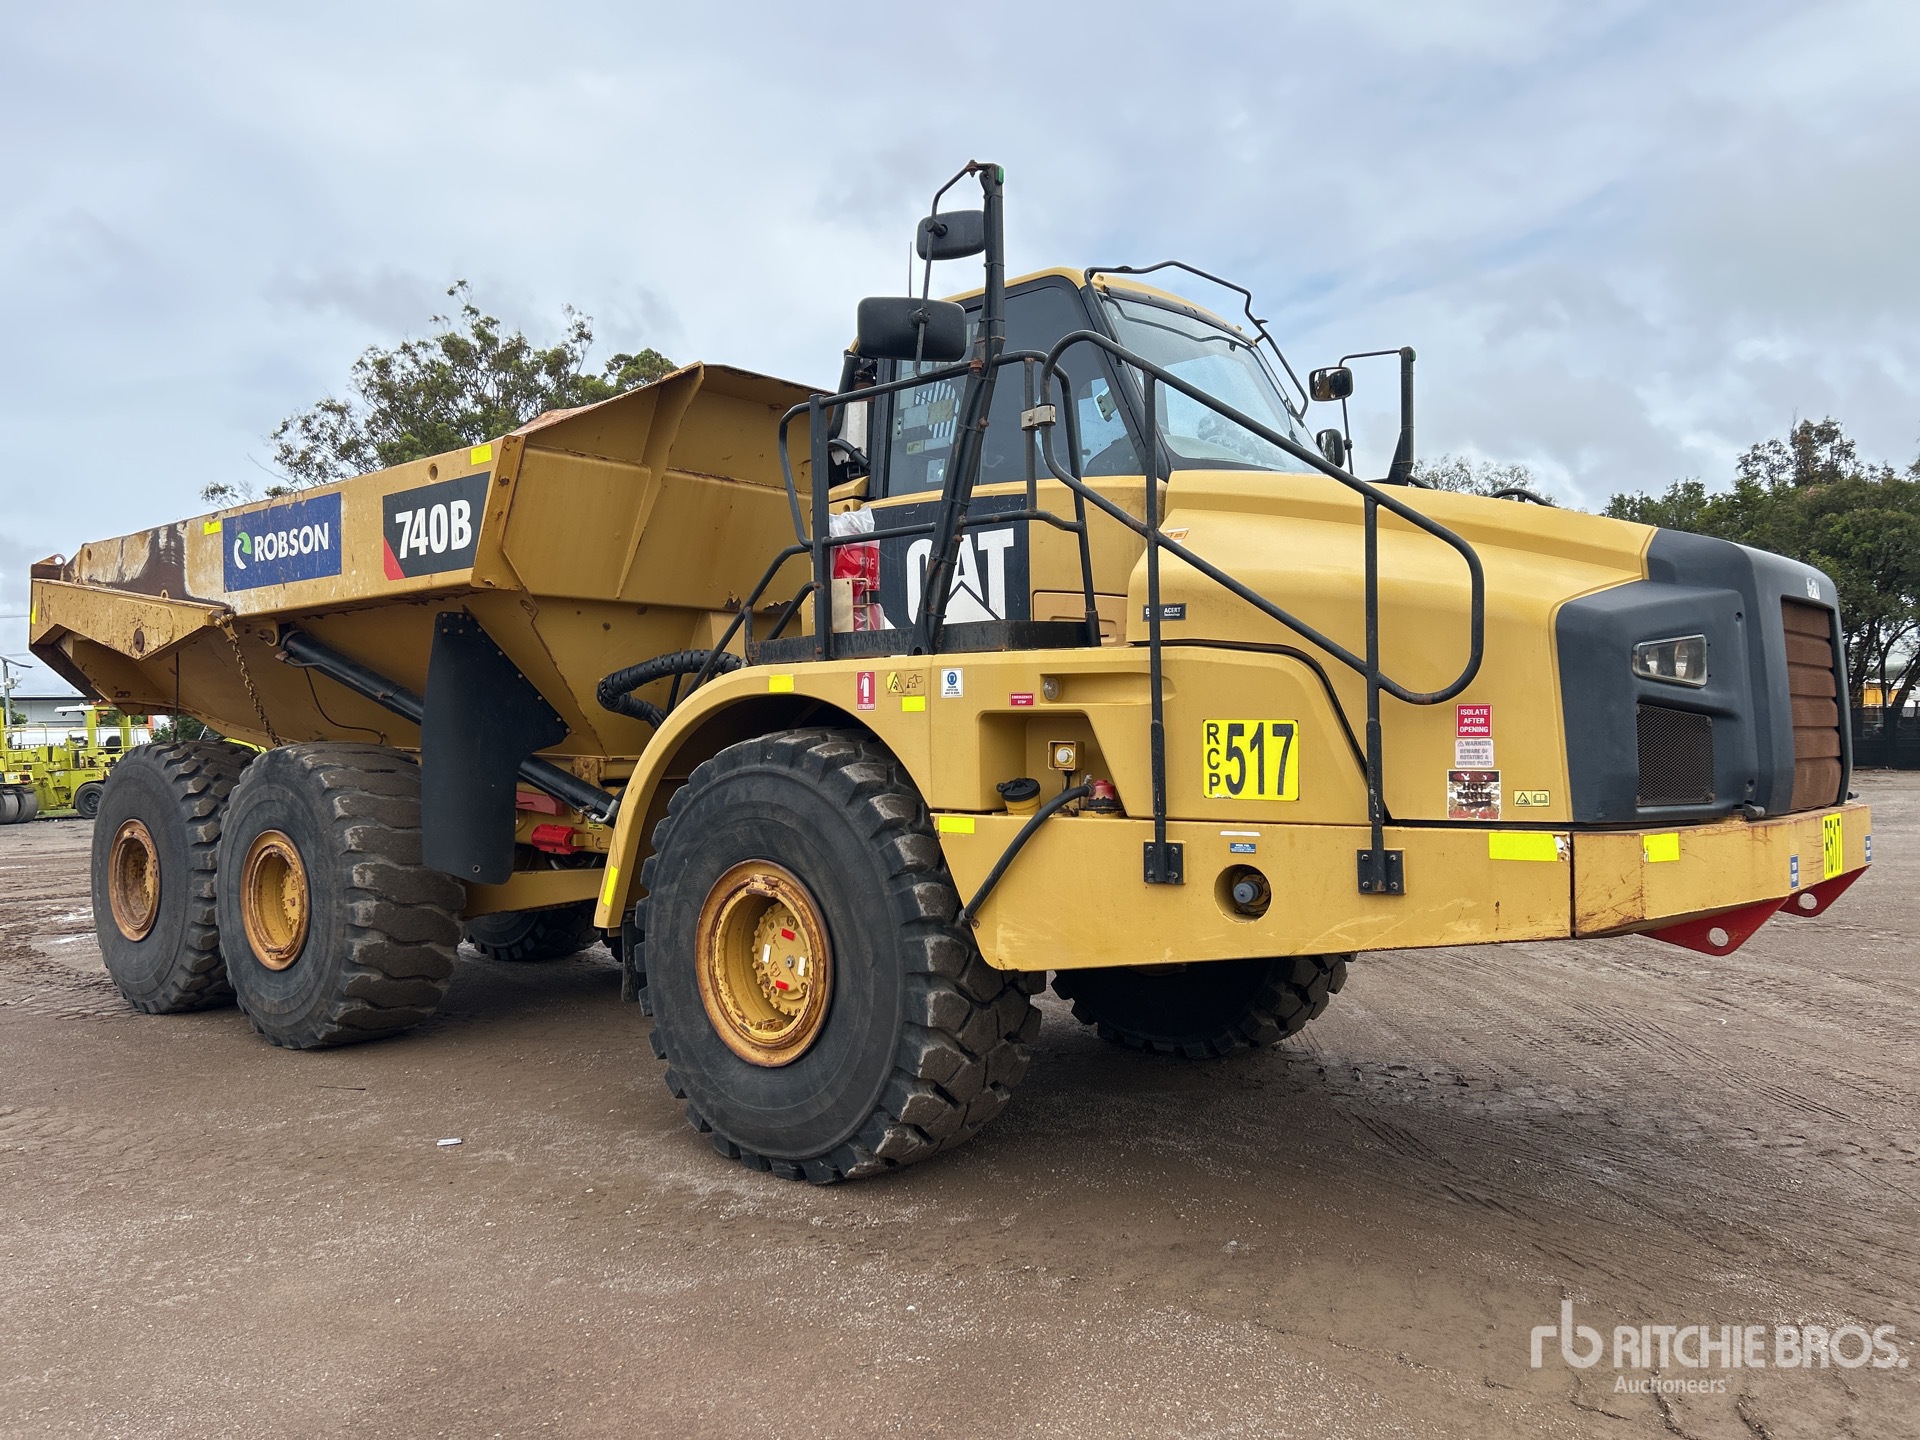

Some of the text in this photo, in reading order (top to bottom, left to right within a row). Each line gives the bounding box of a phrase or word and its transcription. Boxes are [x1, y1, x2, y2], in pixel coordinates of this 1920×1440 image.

[395, 500, 472, 559] 740B
[254, 522, 329, 562] ROBSON
[1460, 708, 1489, 716] ISOLATE
[1225, 722, 1294, 796] 517
[1456, 791, 1492, 800] PARTS
[1463, 783, 1486, 791] HOT
